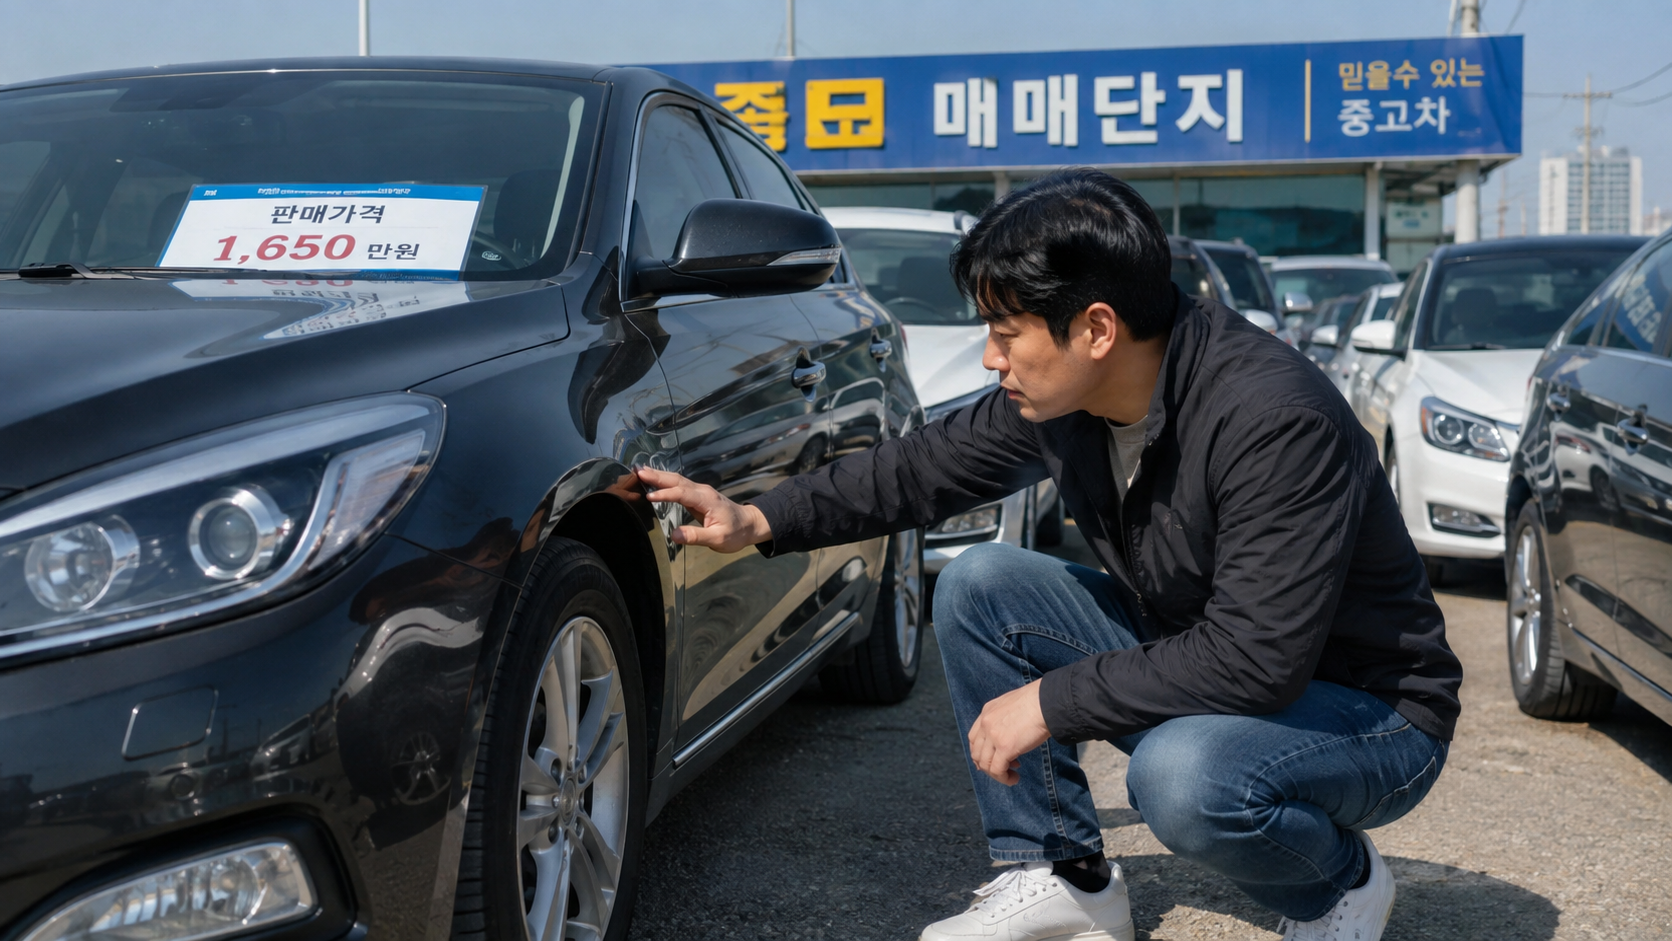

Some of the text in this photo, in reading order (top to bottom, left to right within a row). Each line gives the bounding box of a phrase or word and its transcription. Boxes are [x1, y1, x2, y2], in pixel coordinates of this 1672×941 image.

[1338, 57, 1485, 91] 믿을수 있는
[933, 69, 1243, 148] 매매단지
[1337, 95, 1451, 137] 중고차
[271, 204, 386, 224] 판매가격
[213, 234, 420, 264] 1,650 만원
